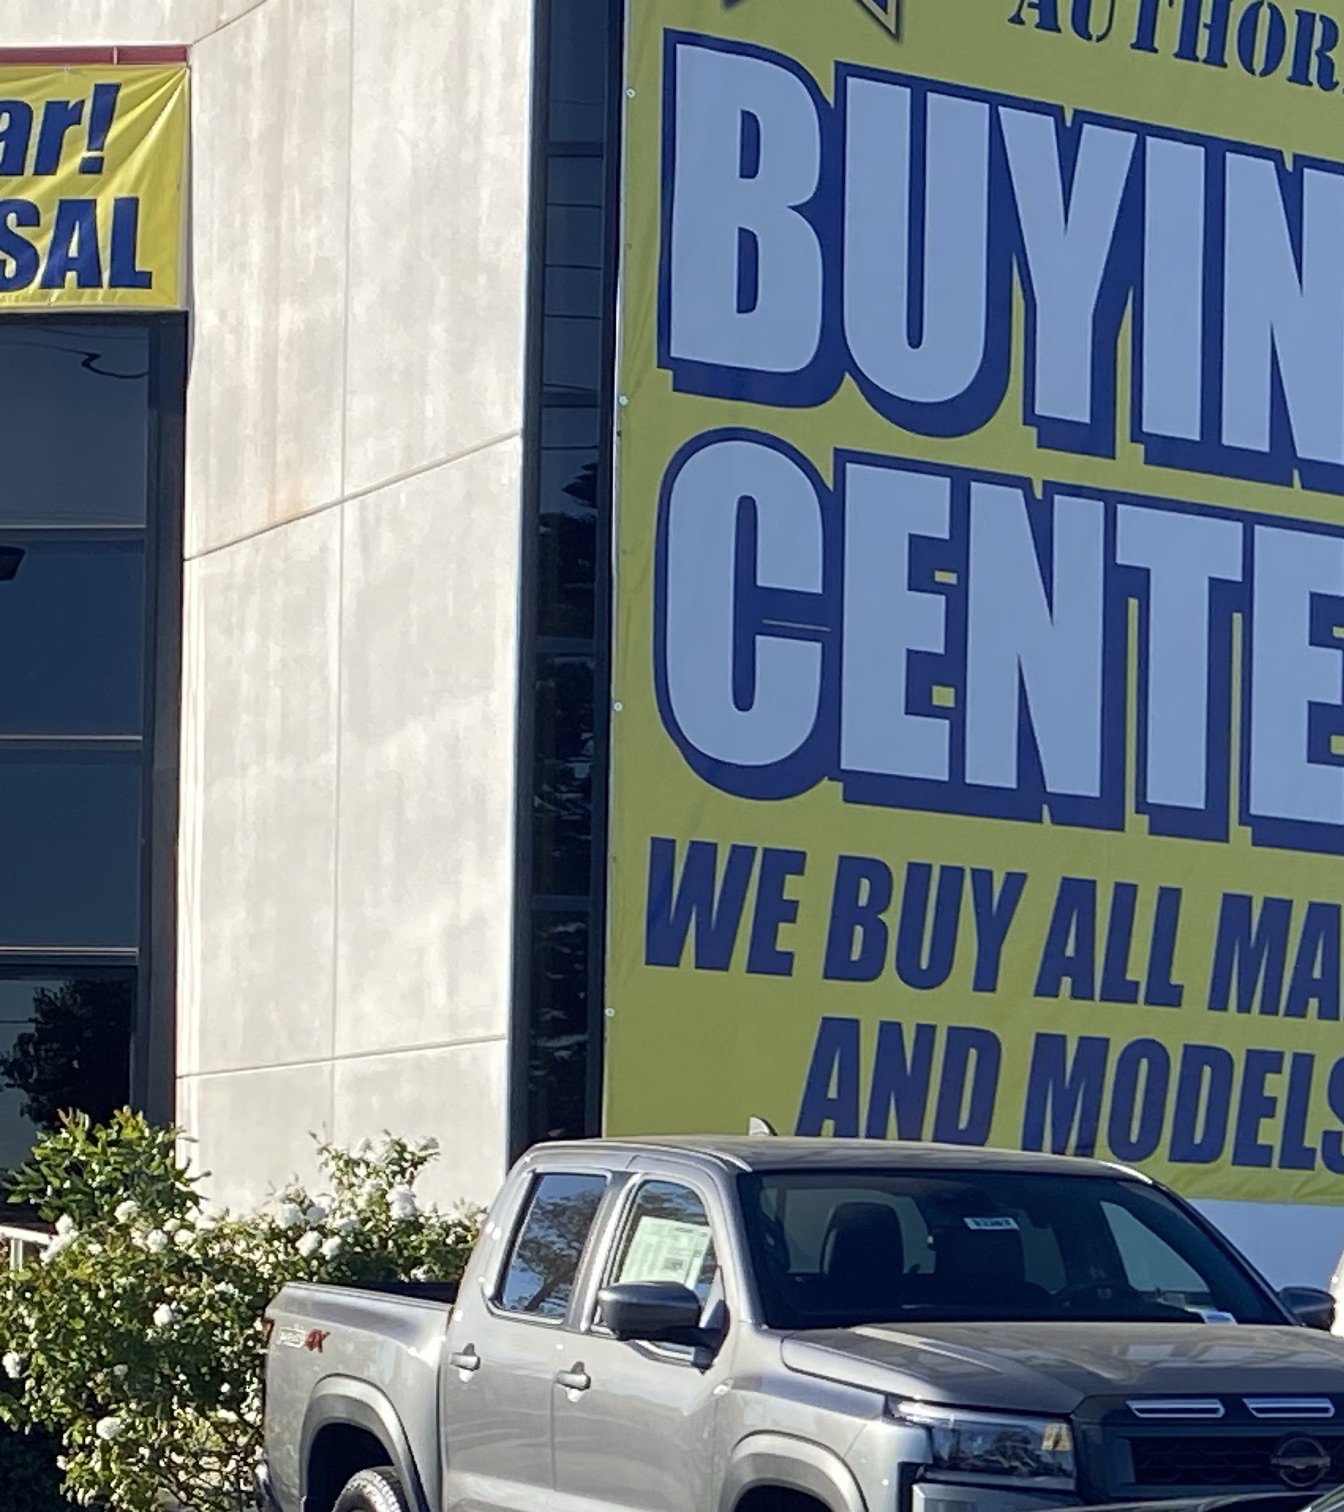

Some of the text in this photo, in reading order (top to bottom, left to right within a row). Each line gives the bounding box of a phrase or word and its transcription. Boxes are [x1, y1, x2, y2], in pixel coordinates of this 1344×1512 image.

[0, 197, 153, 293] SAL
[644, 837, 807, 977] WE
[822, 855, 1027, 993] BUY
[1033, 877, 1184, 1007] ALL
[794, 1016, 1002, 1146] AND
